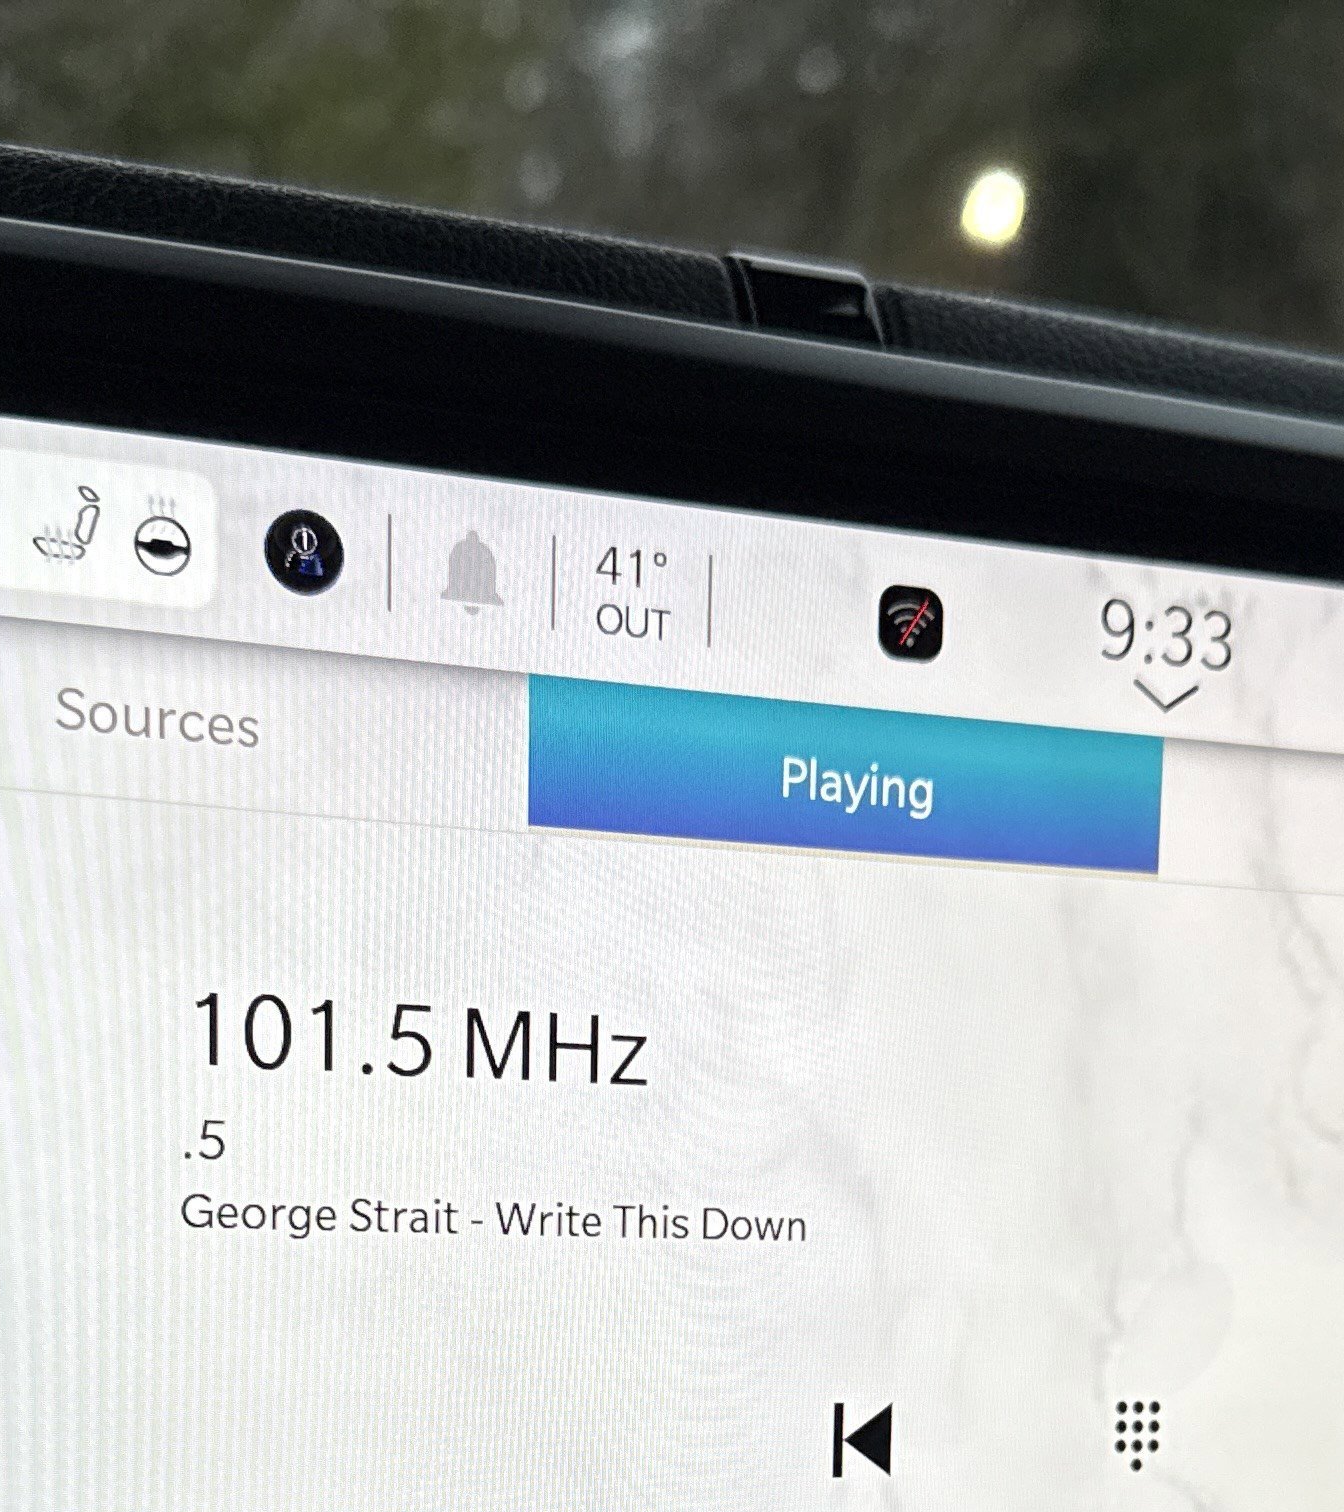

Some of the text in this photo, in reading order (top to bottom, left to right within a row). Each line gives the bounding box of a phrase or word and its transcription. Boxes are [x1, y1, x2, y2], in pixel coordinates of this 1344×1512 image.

[594, 544, 668, 588] 41°
[594, 602, 672, 642] OUT
[1100, 597, 1234, 672] 9:33
[55, 686, 259, 749] Sources
[781, 755, 934, 820] Playing
[195, 991, 649, 1087] 101.5 MHz
[183, 1118, 227, 1162] .5
[179, 1192, 338, 1240] George
[348, 1196, 459, 1236] Strait
[494, 1200, 603, 1239] Write
[611, 1202, 690, 1241] This
[701, 1206, 807, 1243] Down
